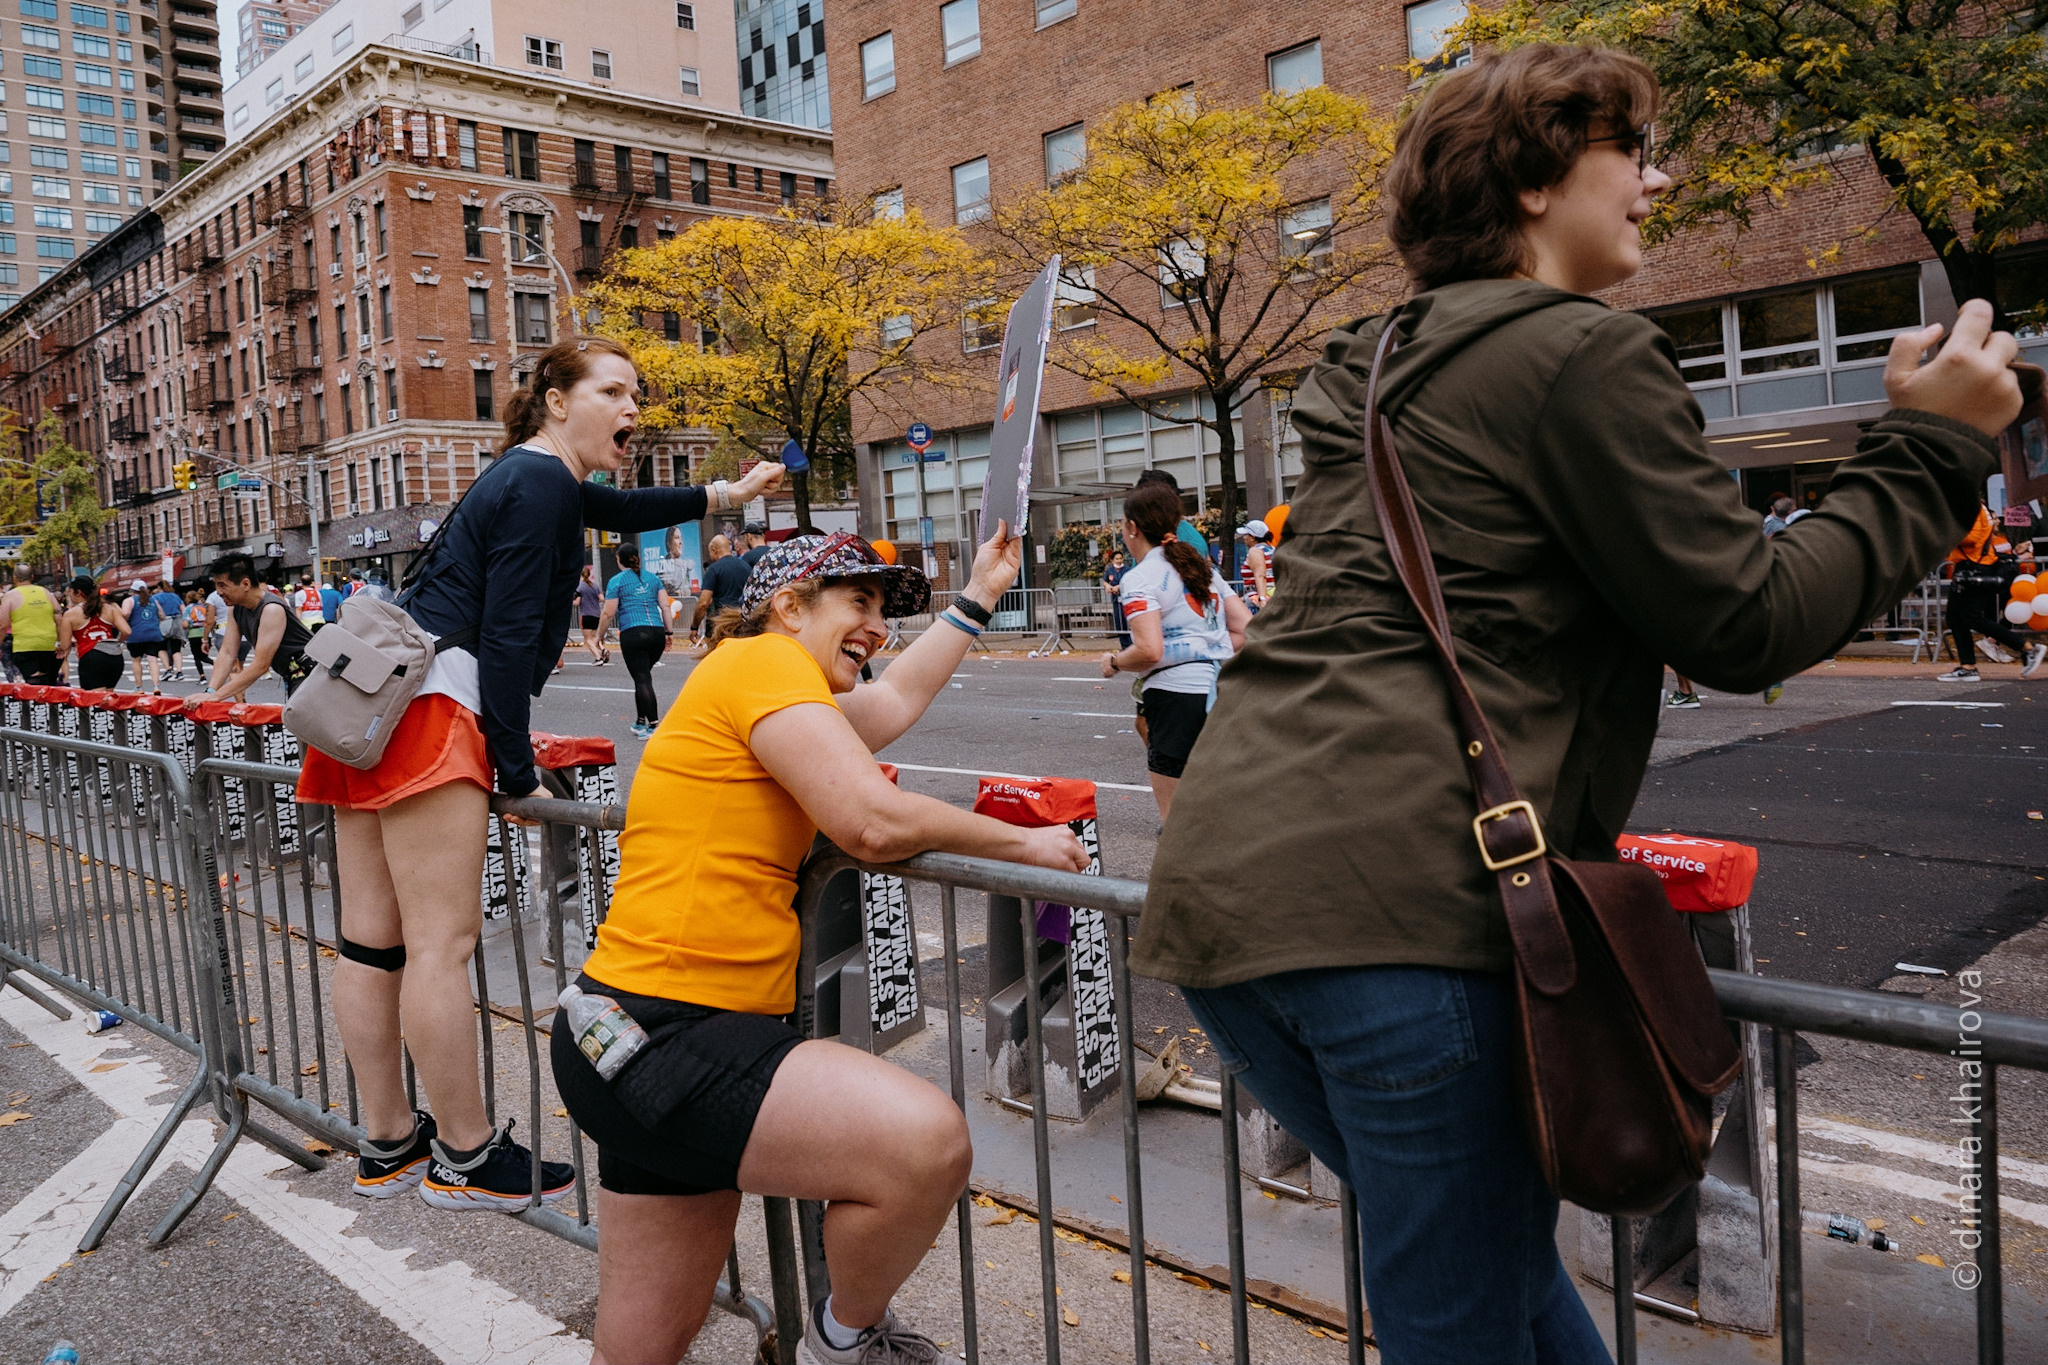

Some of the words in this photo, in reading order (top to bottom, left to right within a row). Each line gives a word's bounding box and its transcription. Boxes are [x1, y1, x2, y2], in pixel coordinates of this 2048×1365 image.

[348, 533, 364, 546] TACO
[374, 529, 391, 543] BELL
[644, 547, 661, 561] STAY
[993, 783, 1003, 794] of
[1004, 784, 1041, 800] Service
[276, 802, 291, 838] STAY
[488, 852, 507, 899] STAY
[1620, 847, 1639, 860] of
[1642, 849, 1706, 873] Service
[871, 873, 890, 929] AMA
[887, 875, 909, 976] AMAZIN
[1075, 907, 1094, 971] AMA
[875, 936, 894, 1003] STAY
[894, 984, 912, 1025] TAY
[1080, 981, 1099, 1055] STAY
[1099, 1033, 1115, 1082] TAY
[432, 1163, 469, 1187] HOKA
